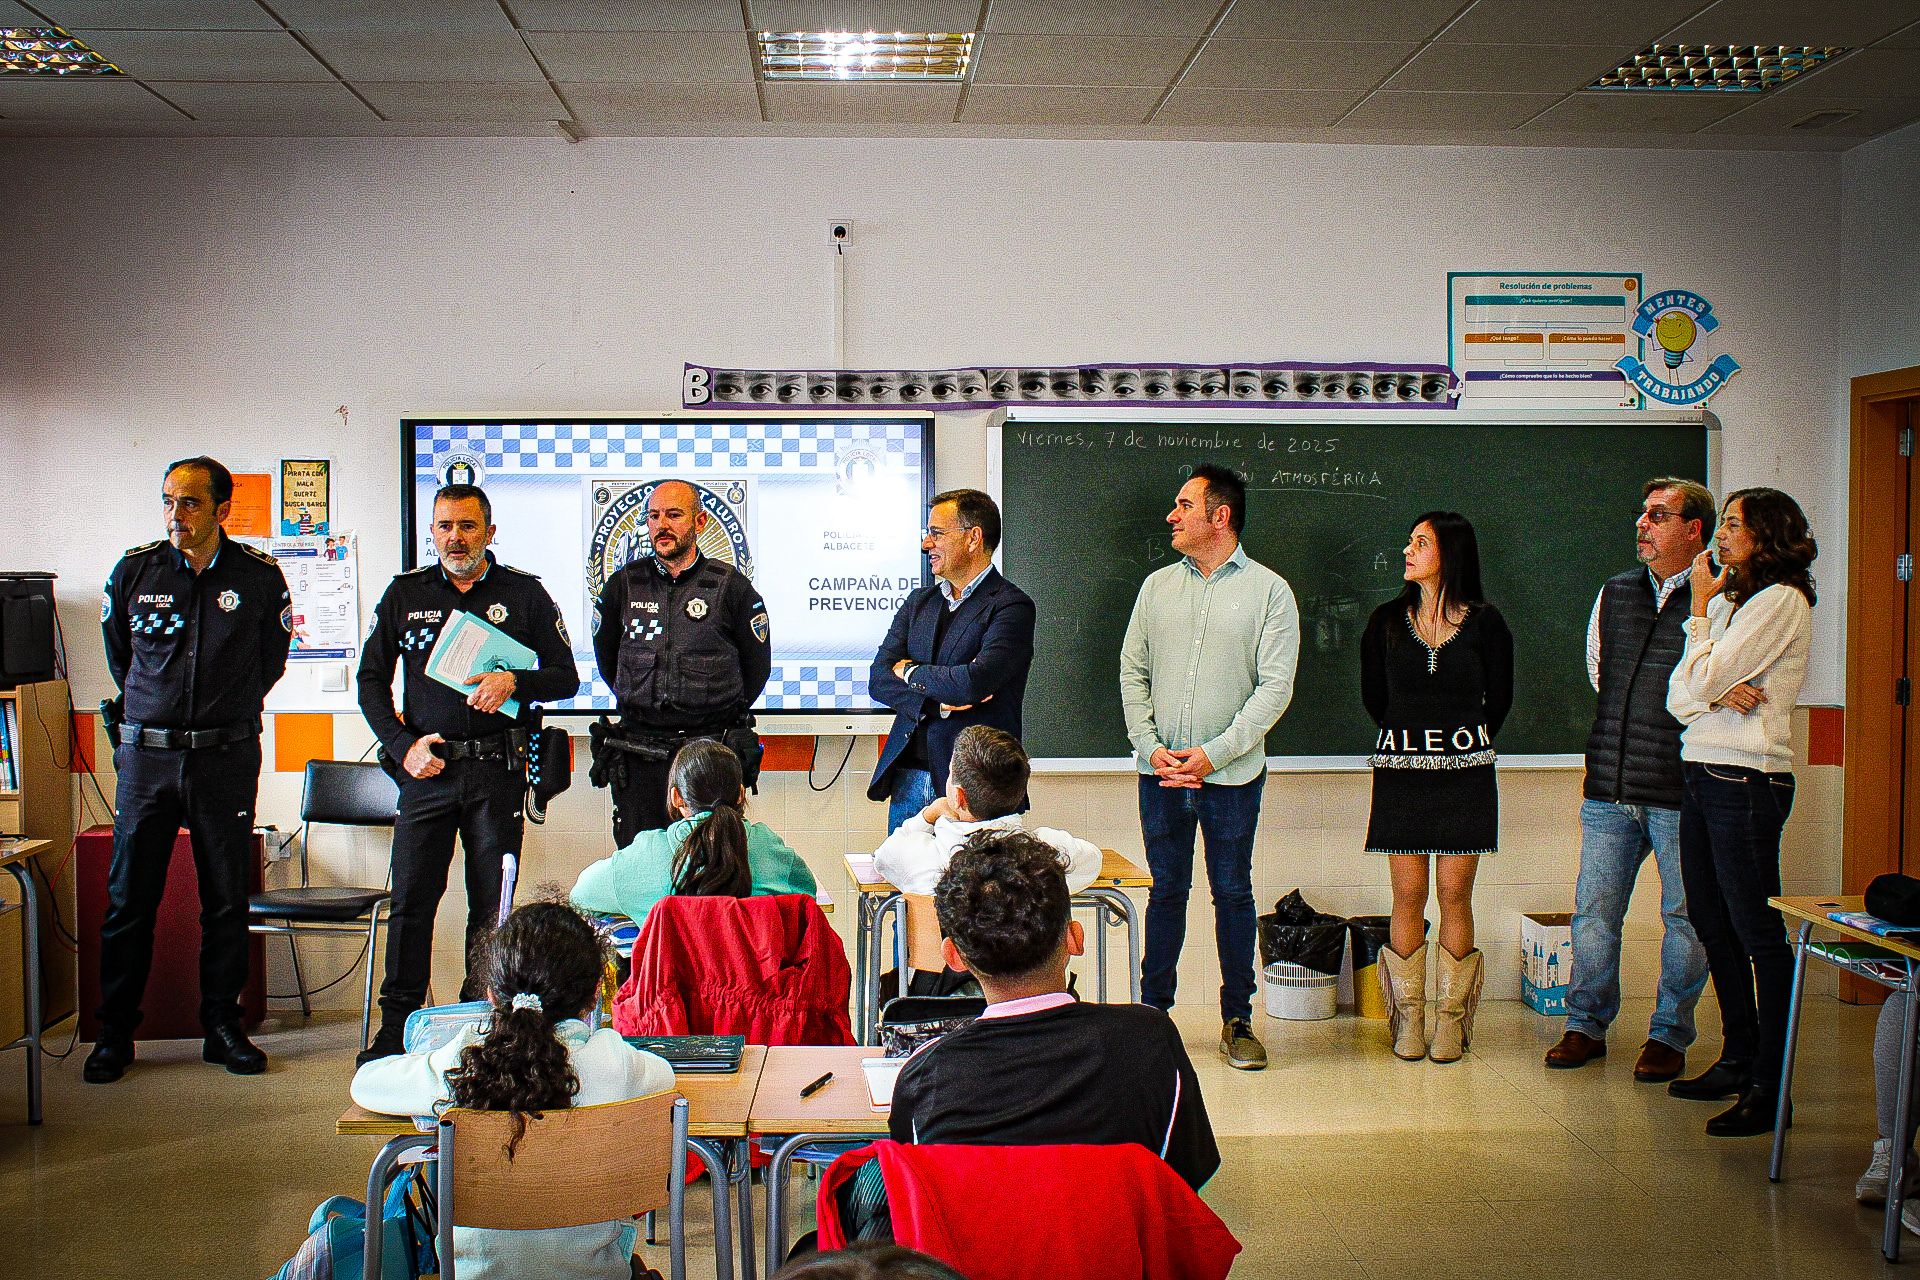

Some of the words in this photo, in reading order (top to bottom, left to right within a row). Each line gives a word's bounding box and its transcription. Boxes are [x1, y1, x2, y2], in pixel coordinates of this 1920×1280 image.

[1499, 281, 1540, 290] Resolución
[1541, 281, 1552, 290] de
[1553, 281, 1593, 292] problemas
[1644, 295, 1706, 315] MENTES
[1637, 372, 1720, 400] TRABAJANDO
[1105, 431, 1116, 449] 7
[1123, 429, 1148, 449] de
[1256, 431, 1276, 451] de
[1286, 437, 1340, 453] 2025
[595, 485, 654, 545] PROYECTO
[808, 574, 893, 591] CAMPAÑA
[898, 577, 920, 590] DE
[138, 594, 174, 603] POLICIA
[631, 601, 659, 609] POLICIA
[808, 594, 906, 611] PREVENCIÓ
[407, 610, 442, 620] POLICIA
